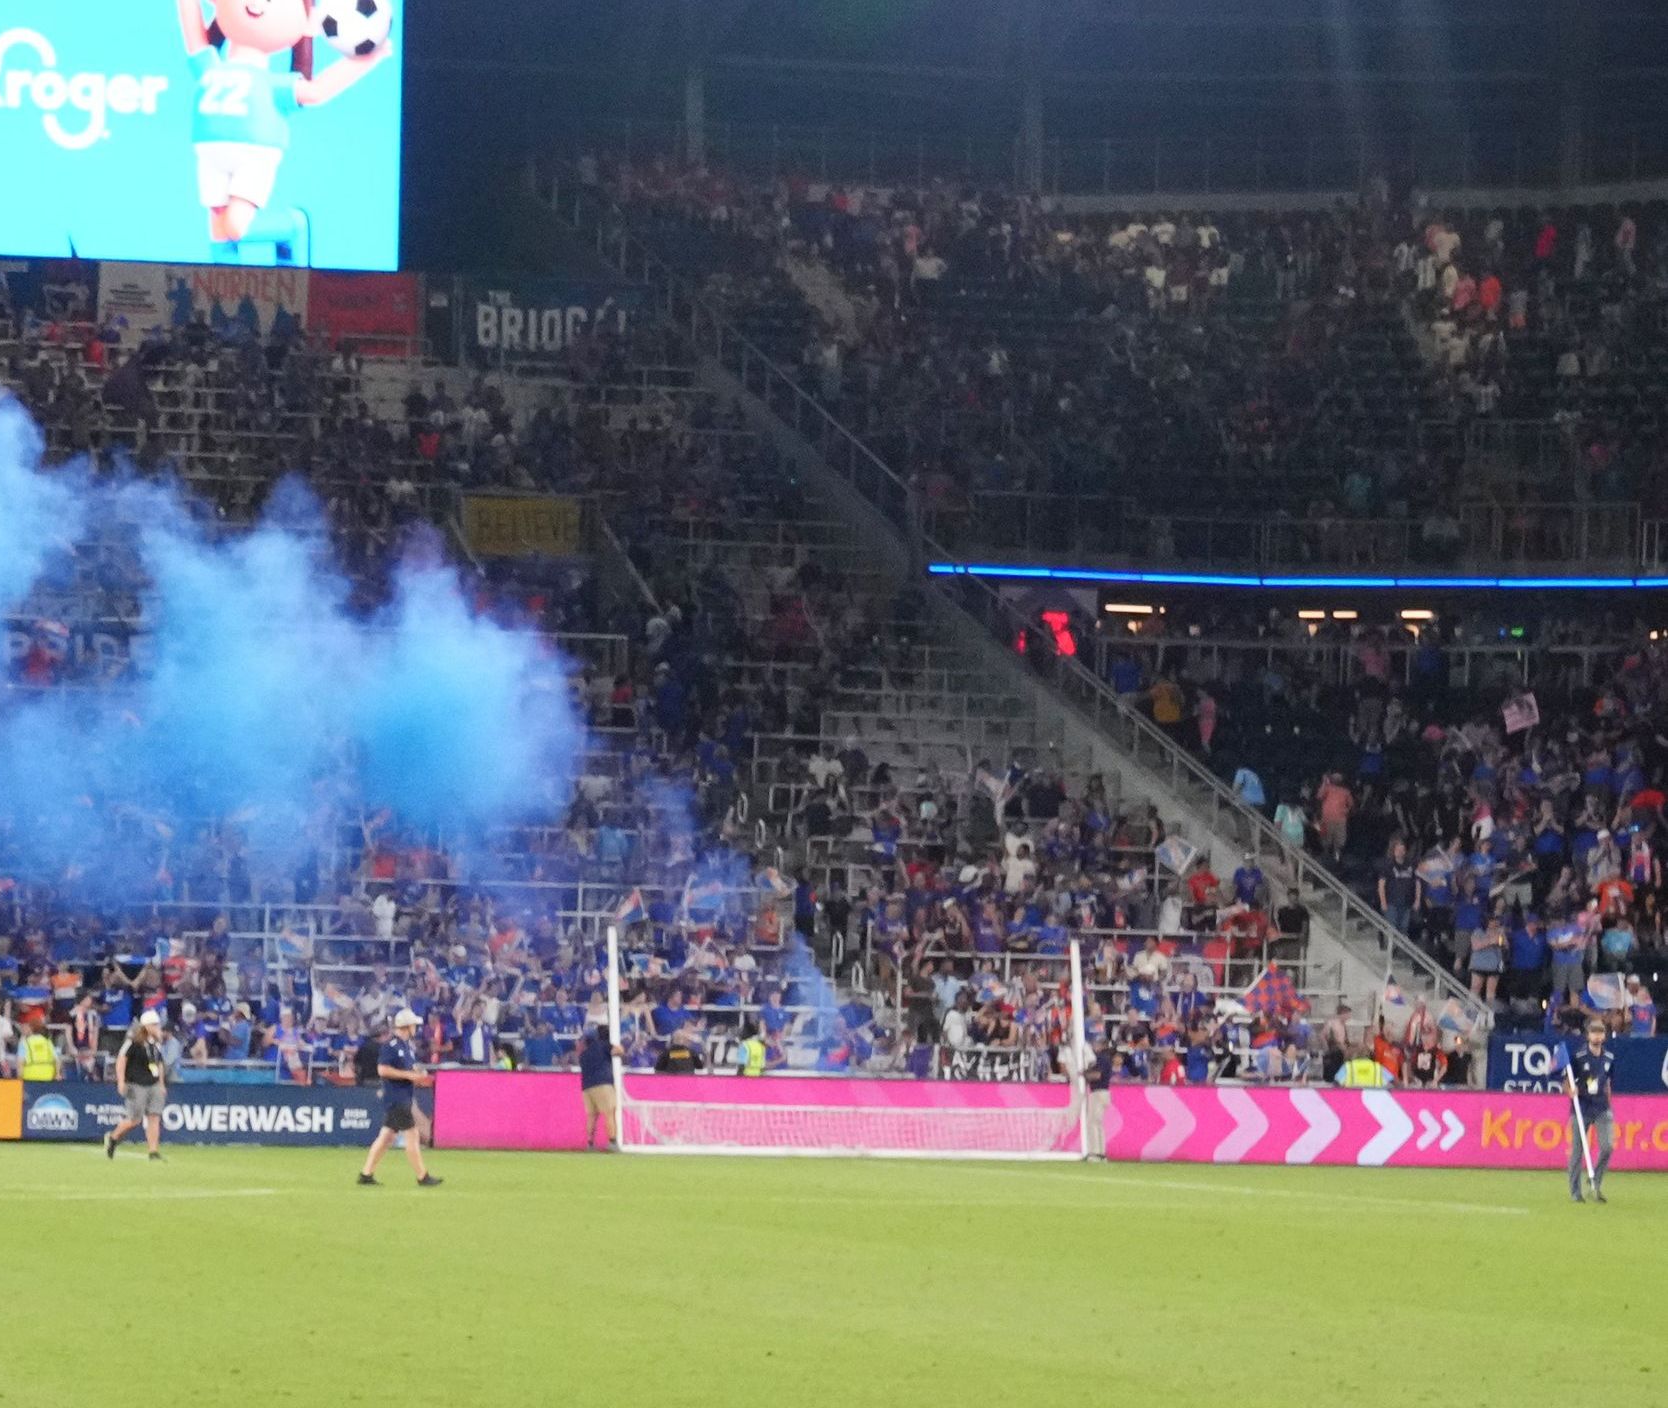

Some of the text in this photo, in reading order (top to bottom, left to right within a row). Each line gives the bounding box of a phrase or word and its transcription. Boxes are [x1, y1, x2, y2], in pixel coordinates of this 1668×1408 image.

[198, 68, 253, 117] 22
[27, 1108, 78, 1130] DAWN
[143, 1103, 334, 1133] OWERWASH
